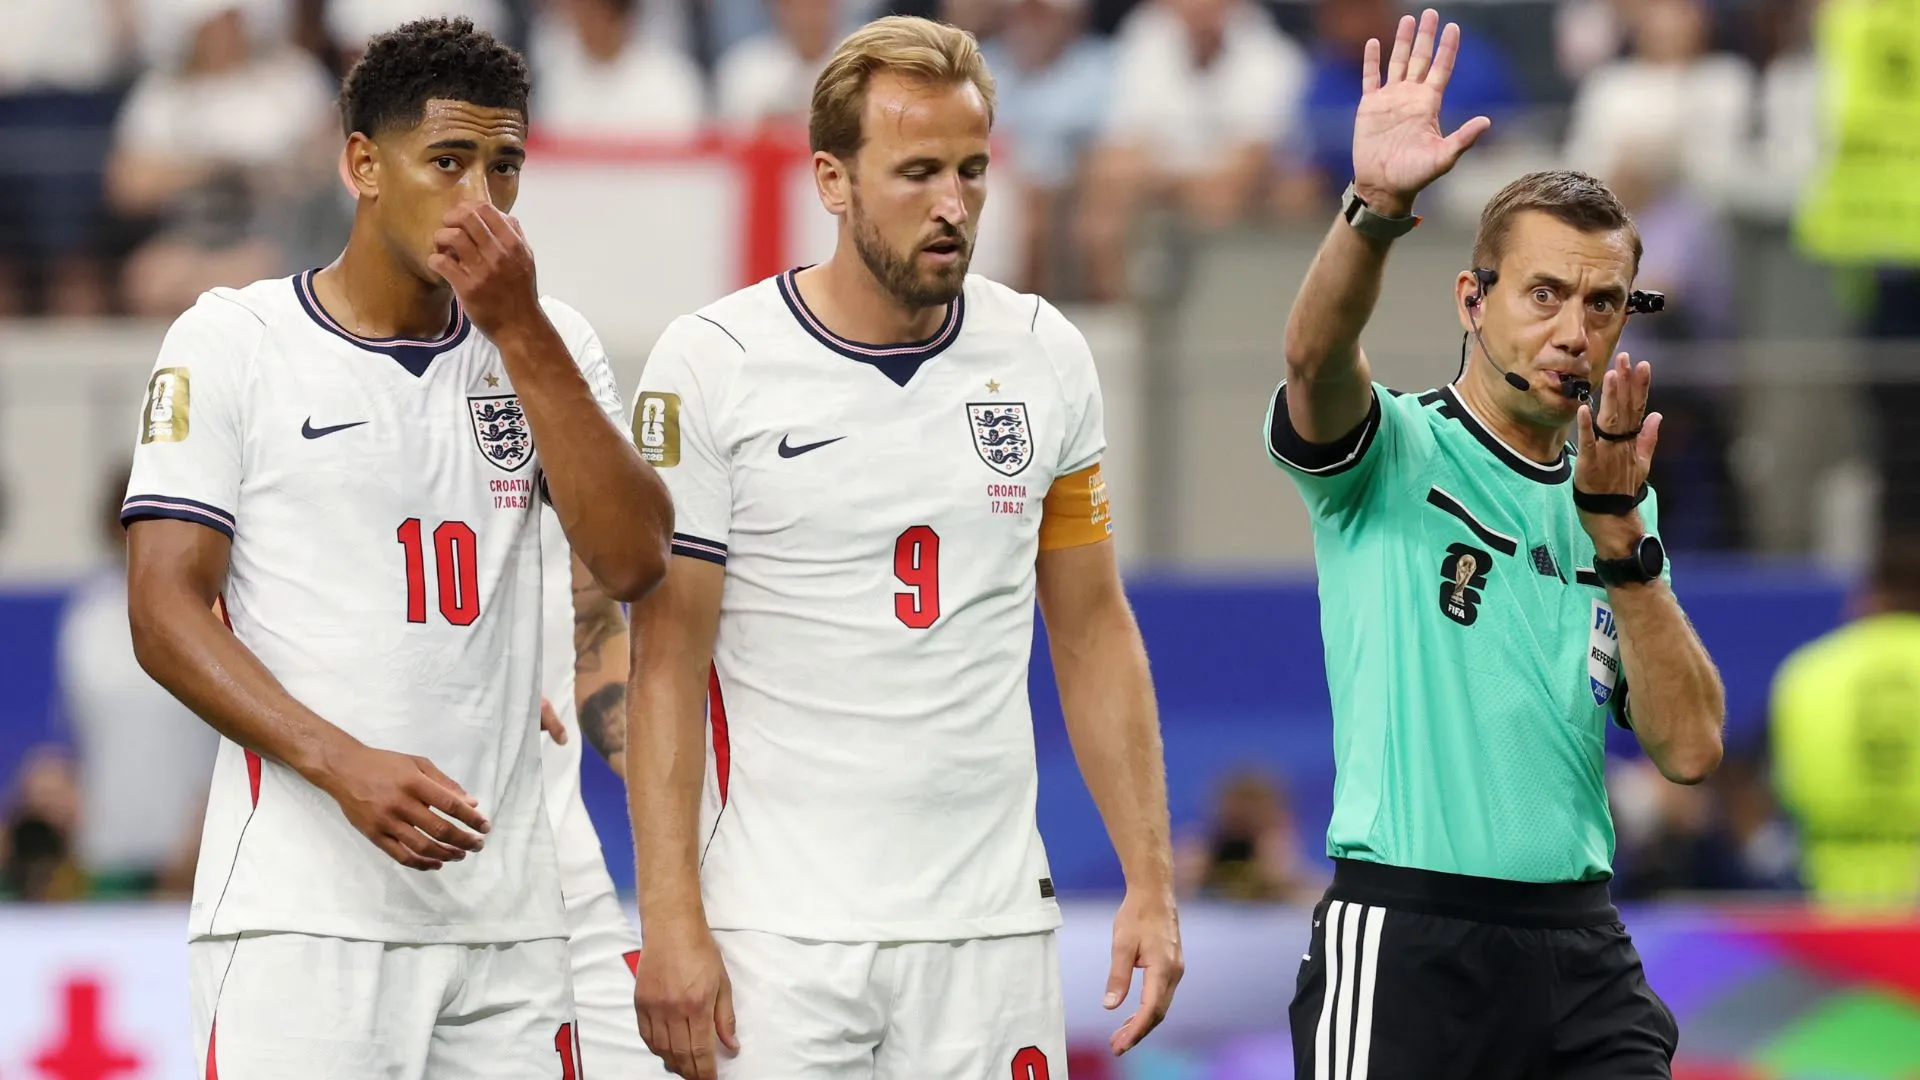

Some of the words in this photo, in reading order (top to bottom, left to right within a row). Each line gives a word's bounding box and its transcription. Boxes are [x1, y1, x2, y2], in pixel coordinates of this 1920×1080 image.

[490, 479, 530, 492] CROATIA
[987, 484, 1027, 498] CROATIA
[397, 517, 480, 625] 10
[894, 525, 940, 629] 9
[1448, 603, 1465, 619] FIFA
[1591, 646, 1617, 673] REFEREE
[1594, 683, 1607, 699] 2026
